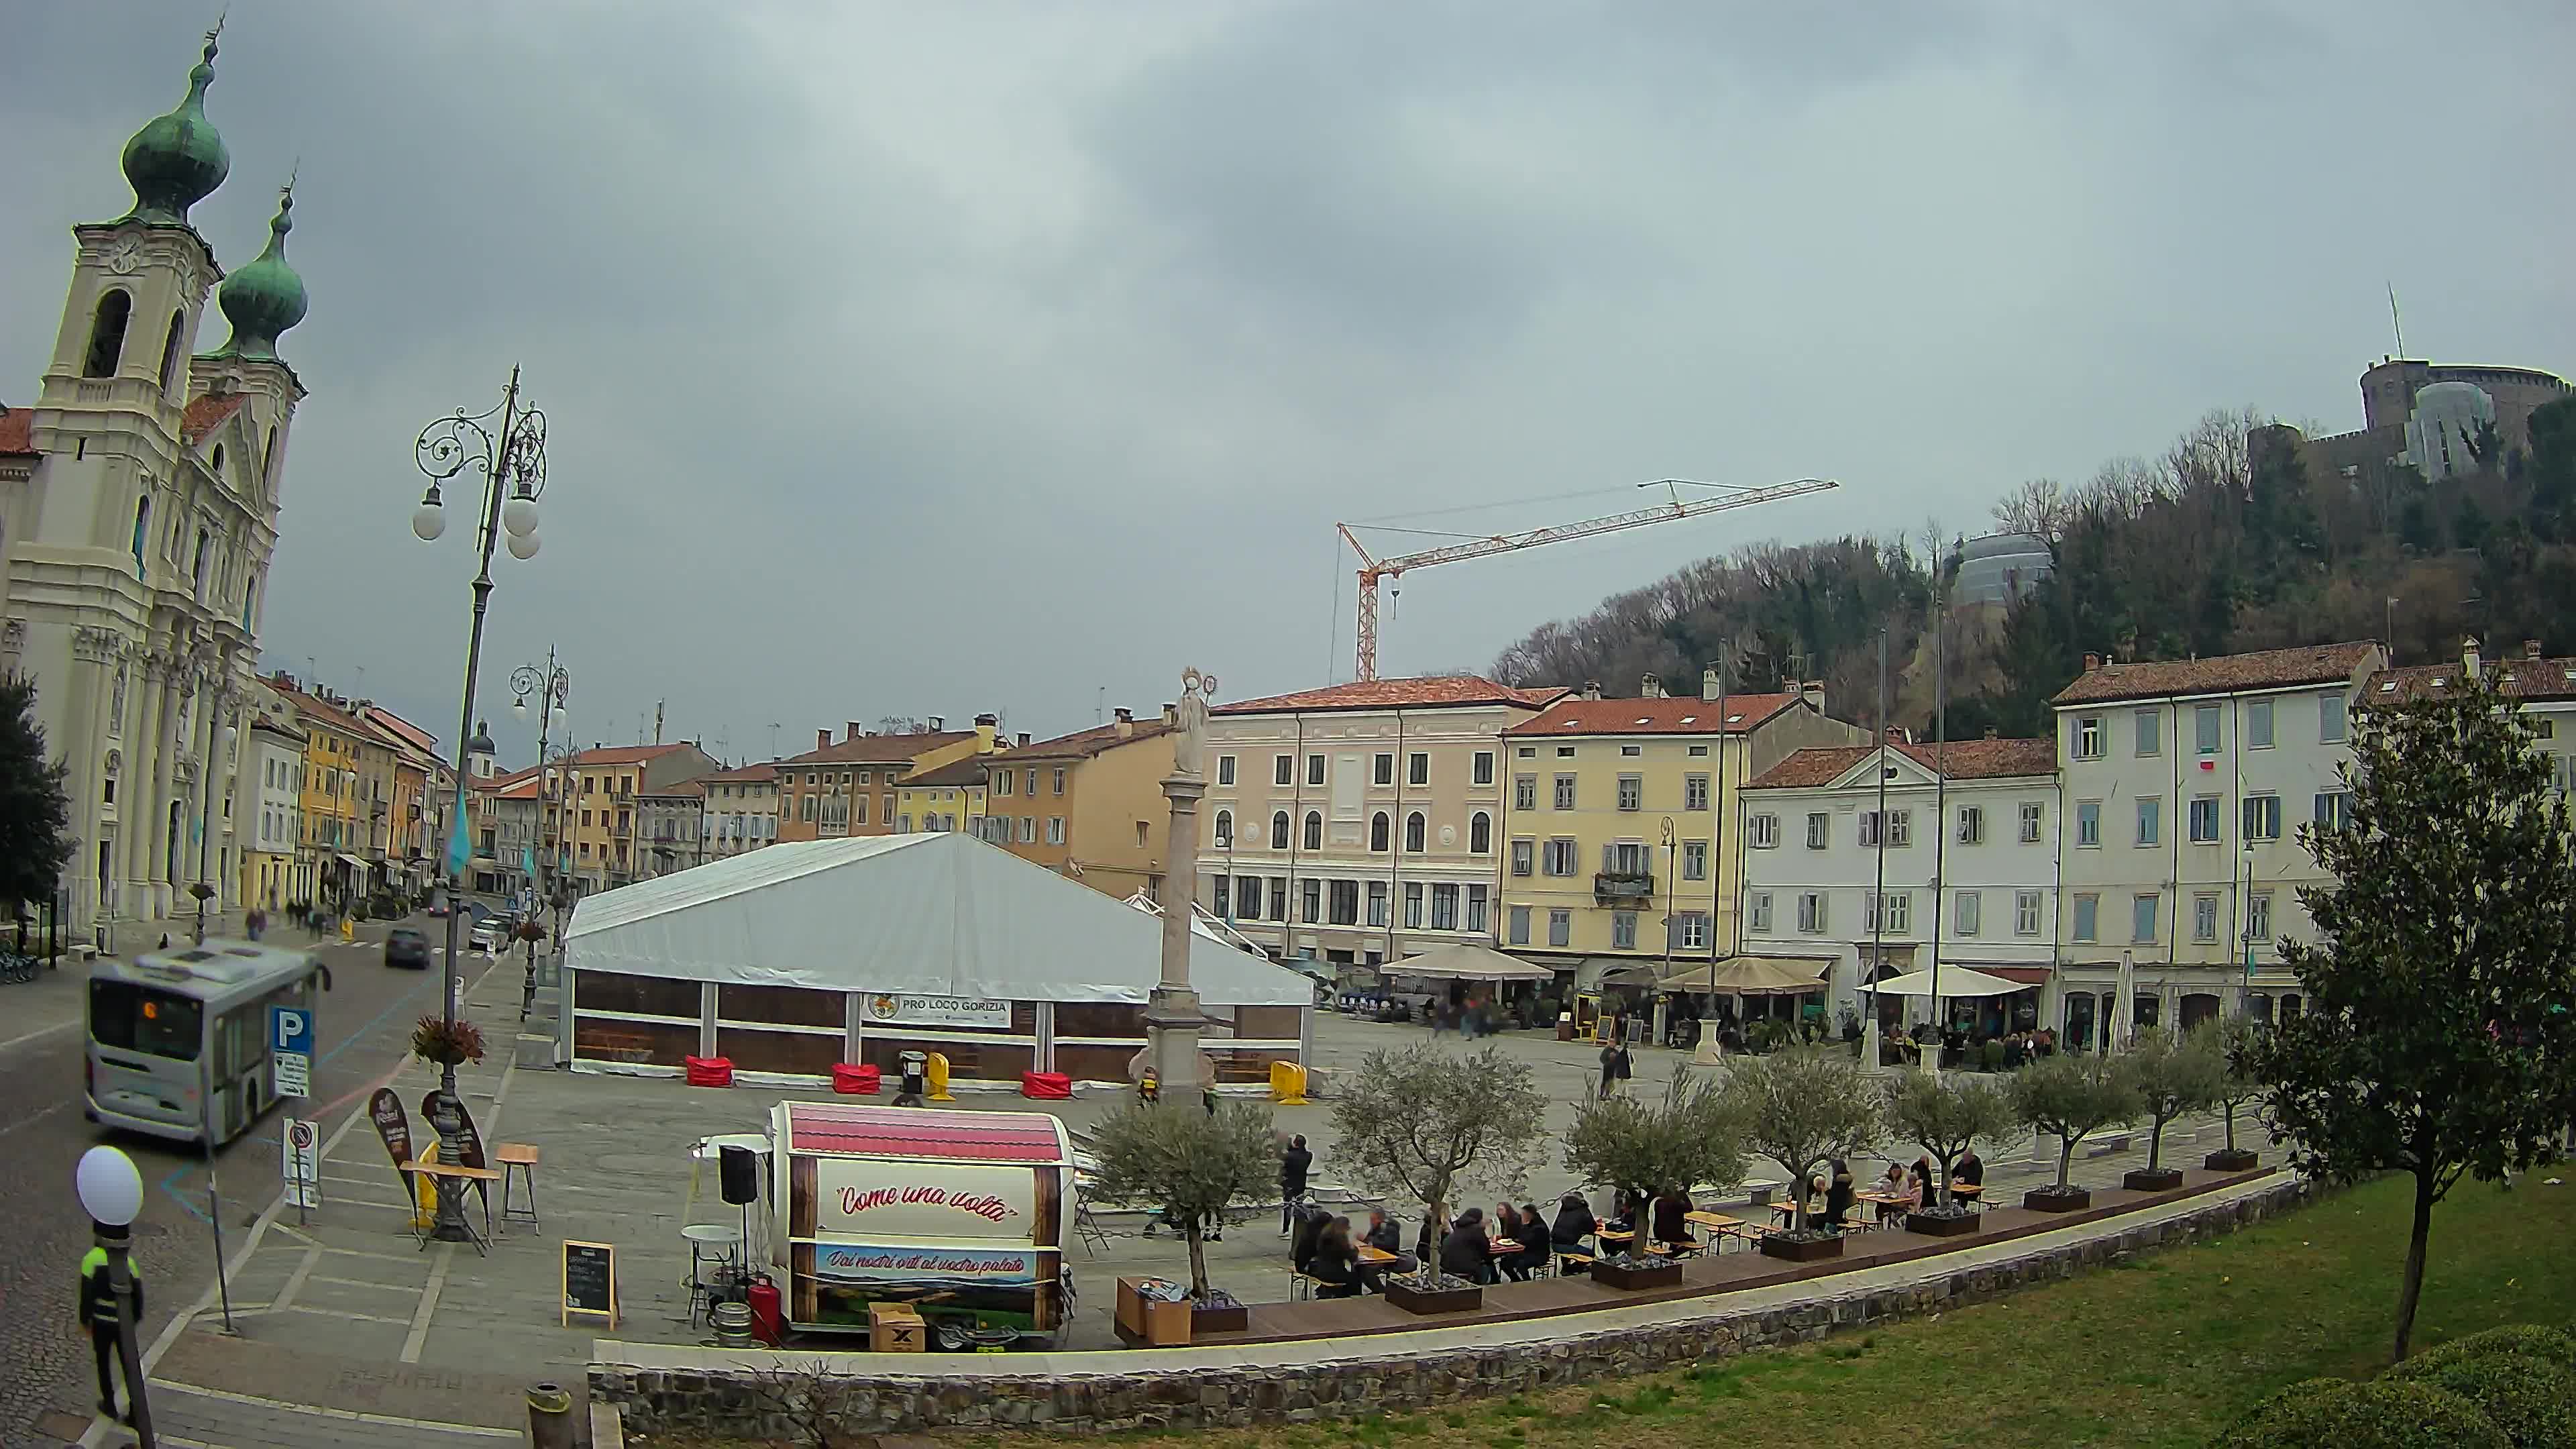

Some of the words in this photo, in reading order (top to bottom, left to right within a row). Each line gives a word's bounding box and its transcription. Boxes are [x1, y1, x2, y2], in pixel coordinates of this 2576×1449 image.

[903, 1000, 926, 1010] PRO
[962, 1002, 1006, 1012] GORIZIA
[279, 1012, 303, 1047] P
[902, 1186, 947, 1205] una
[826, 1250, 855, 1267] Dai
[856, 1253, 896, 1269] nostri
[896, 1254, 920, 1269] orti
[920, 1256, 938, 1270] al
[937, 1258, 978, 1272] vostro
[977, 1257, 1024, 1277] palato
